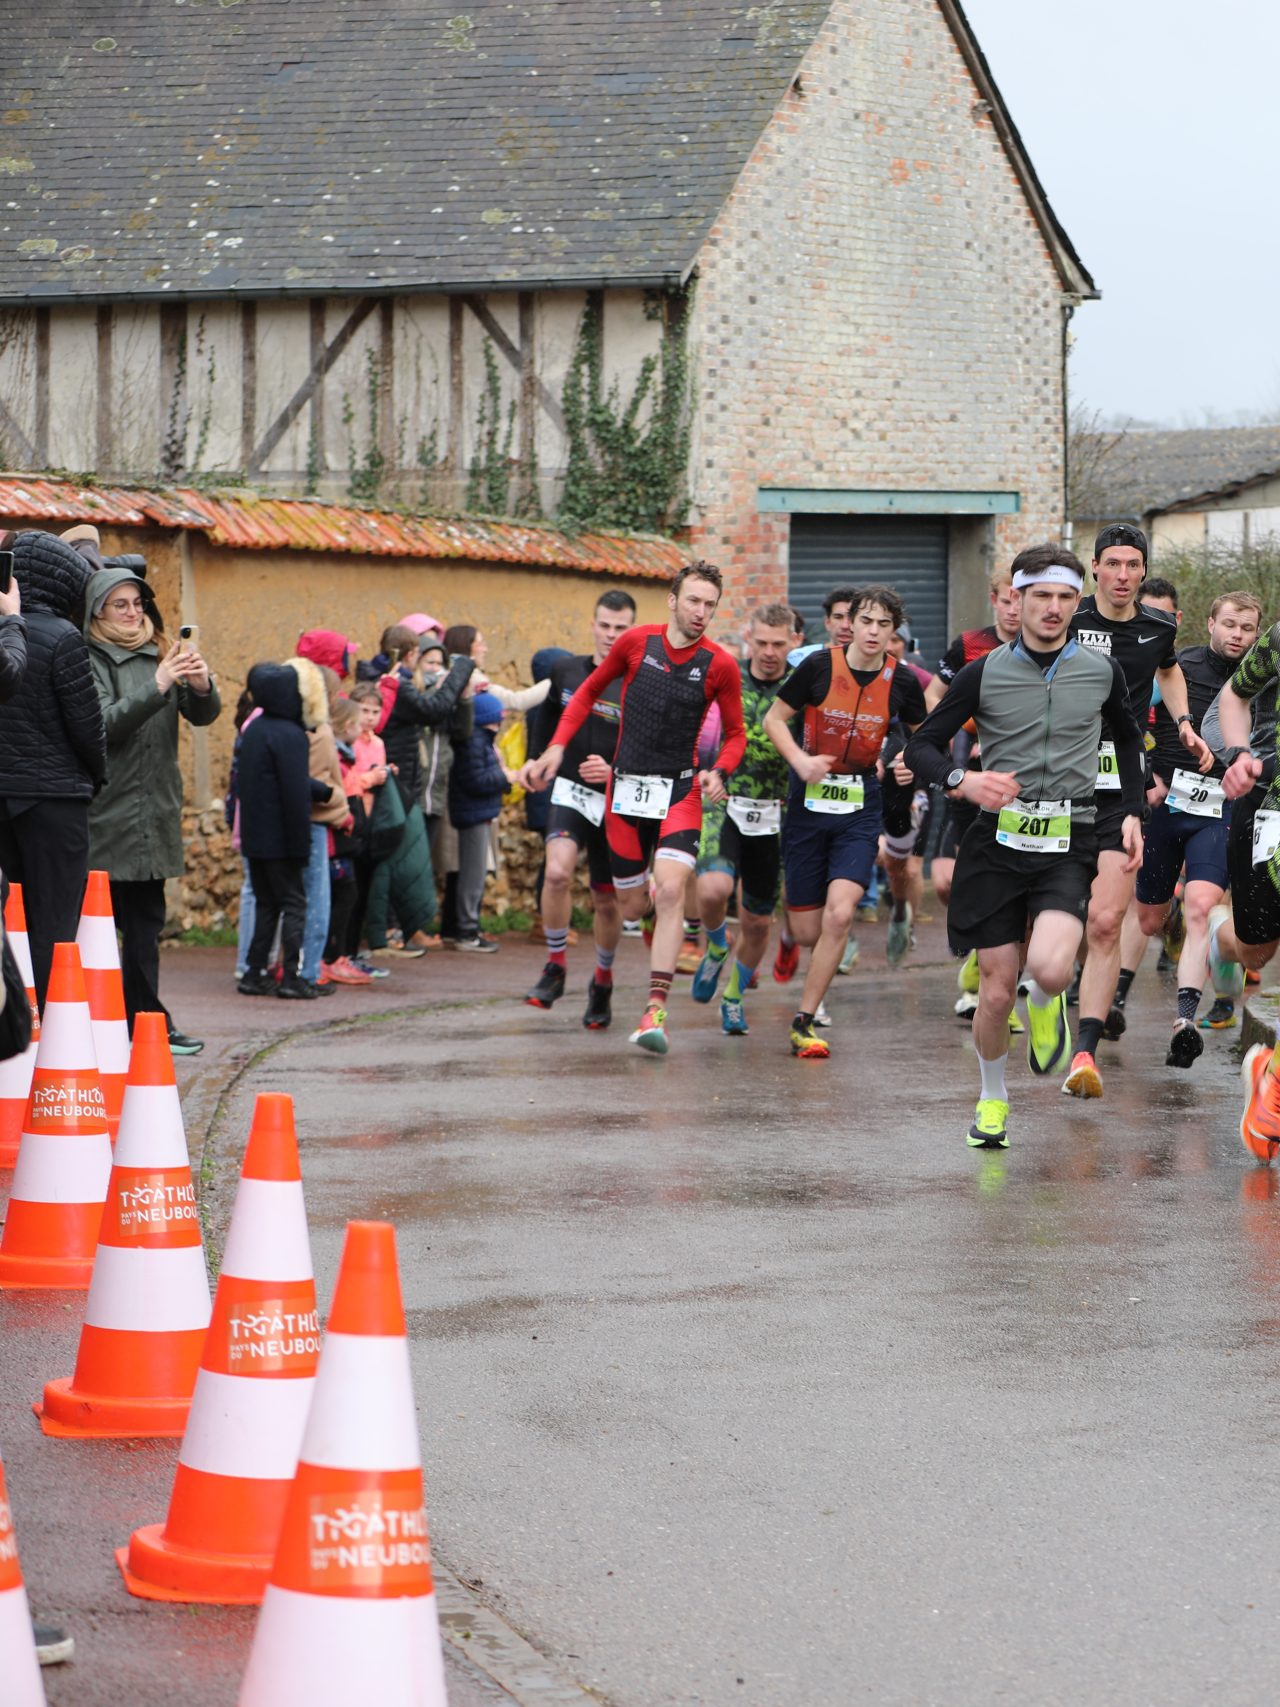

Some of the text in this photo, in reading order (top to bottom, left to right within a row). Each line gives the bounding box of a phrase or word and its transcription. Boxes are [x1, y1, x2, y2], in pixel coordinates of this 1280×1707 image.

[1082, 633, 1112, 648] ZAZA
[824, 707, 848, 719] LES
[635, 787, 650, 803] 31
[821, 785, 848, 801] 208
[1189, 787, 1208, 803] 20
[746, 811, 761, 823] 67
[1018, 815, 1051, 836] 207
